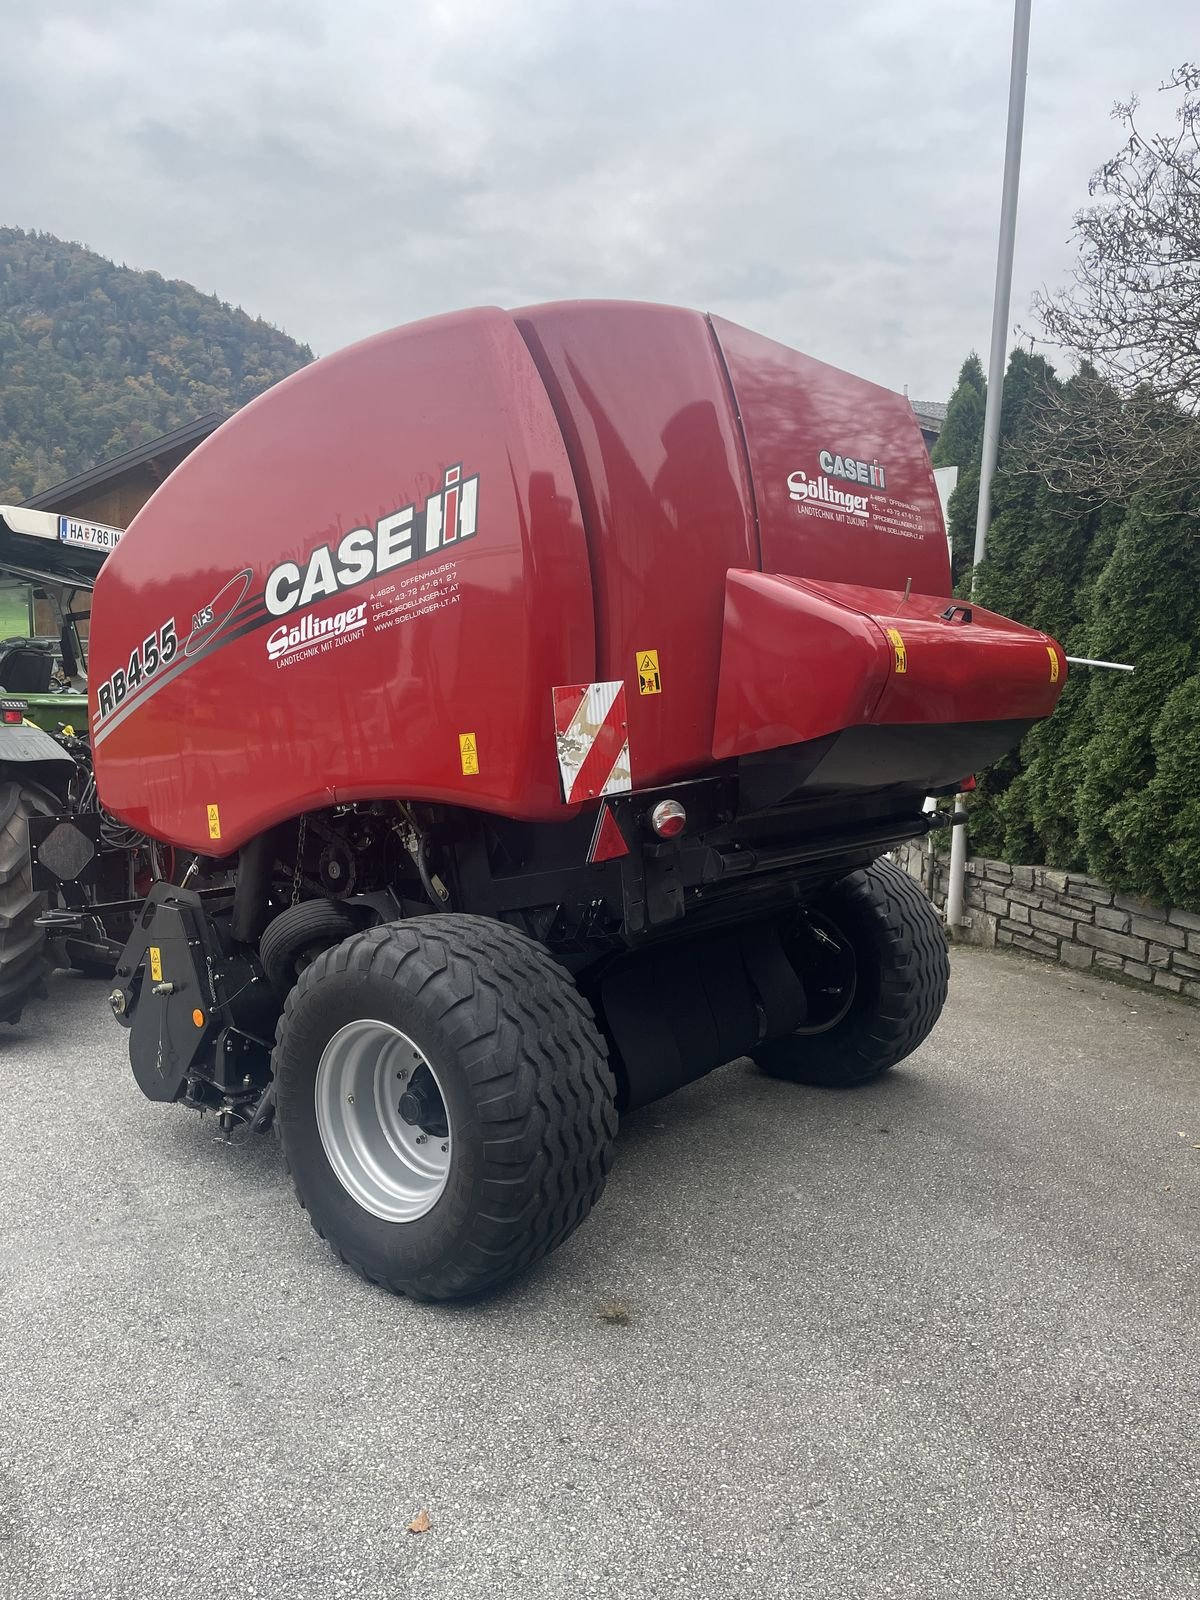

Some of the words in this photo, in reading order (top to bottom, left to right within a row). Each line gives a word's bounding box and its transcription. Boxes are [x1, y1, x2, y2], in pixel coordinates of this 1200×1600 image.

[819, 449, 869, 484] CASE
[786, 470, 869, 513] Söllinger
[70, 523, 84, 540] HA
[91, 528, 109, 545] 786
[797, 504, 835, 521] LANDTECHNIK
[836, 513, 845, 523] MIT
[846, 515, 868, 528] ZUKUNFT
[263, 504, 416, 617] CASE
[400, 561, 457, 588] OFFENHAUSEN
[266, 601, 367, 660] Söllinger
[276, 645, 320, 669] LANDTECHNIK
[320, 640, 334, 653] MIT
[335, 628, 365, 648] ZUKUNFT
[97, 616, 178, 720] RB455
